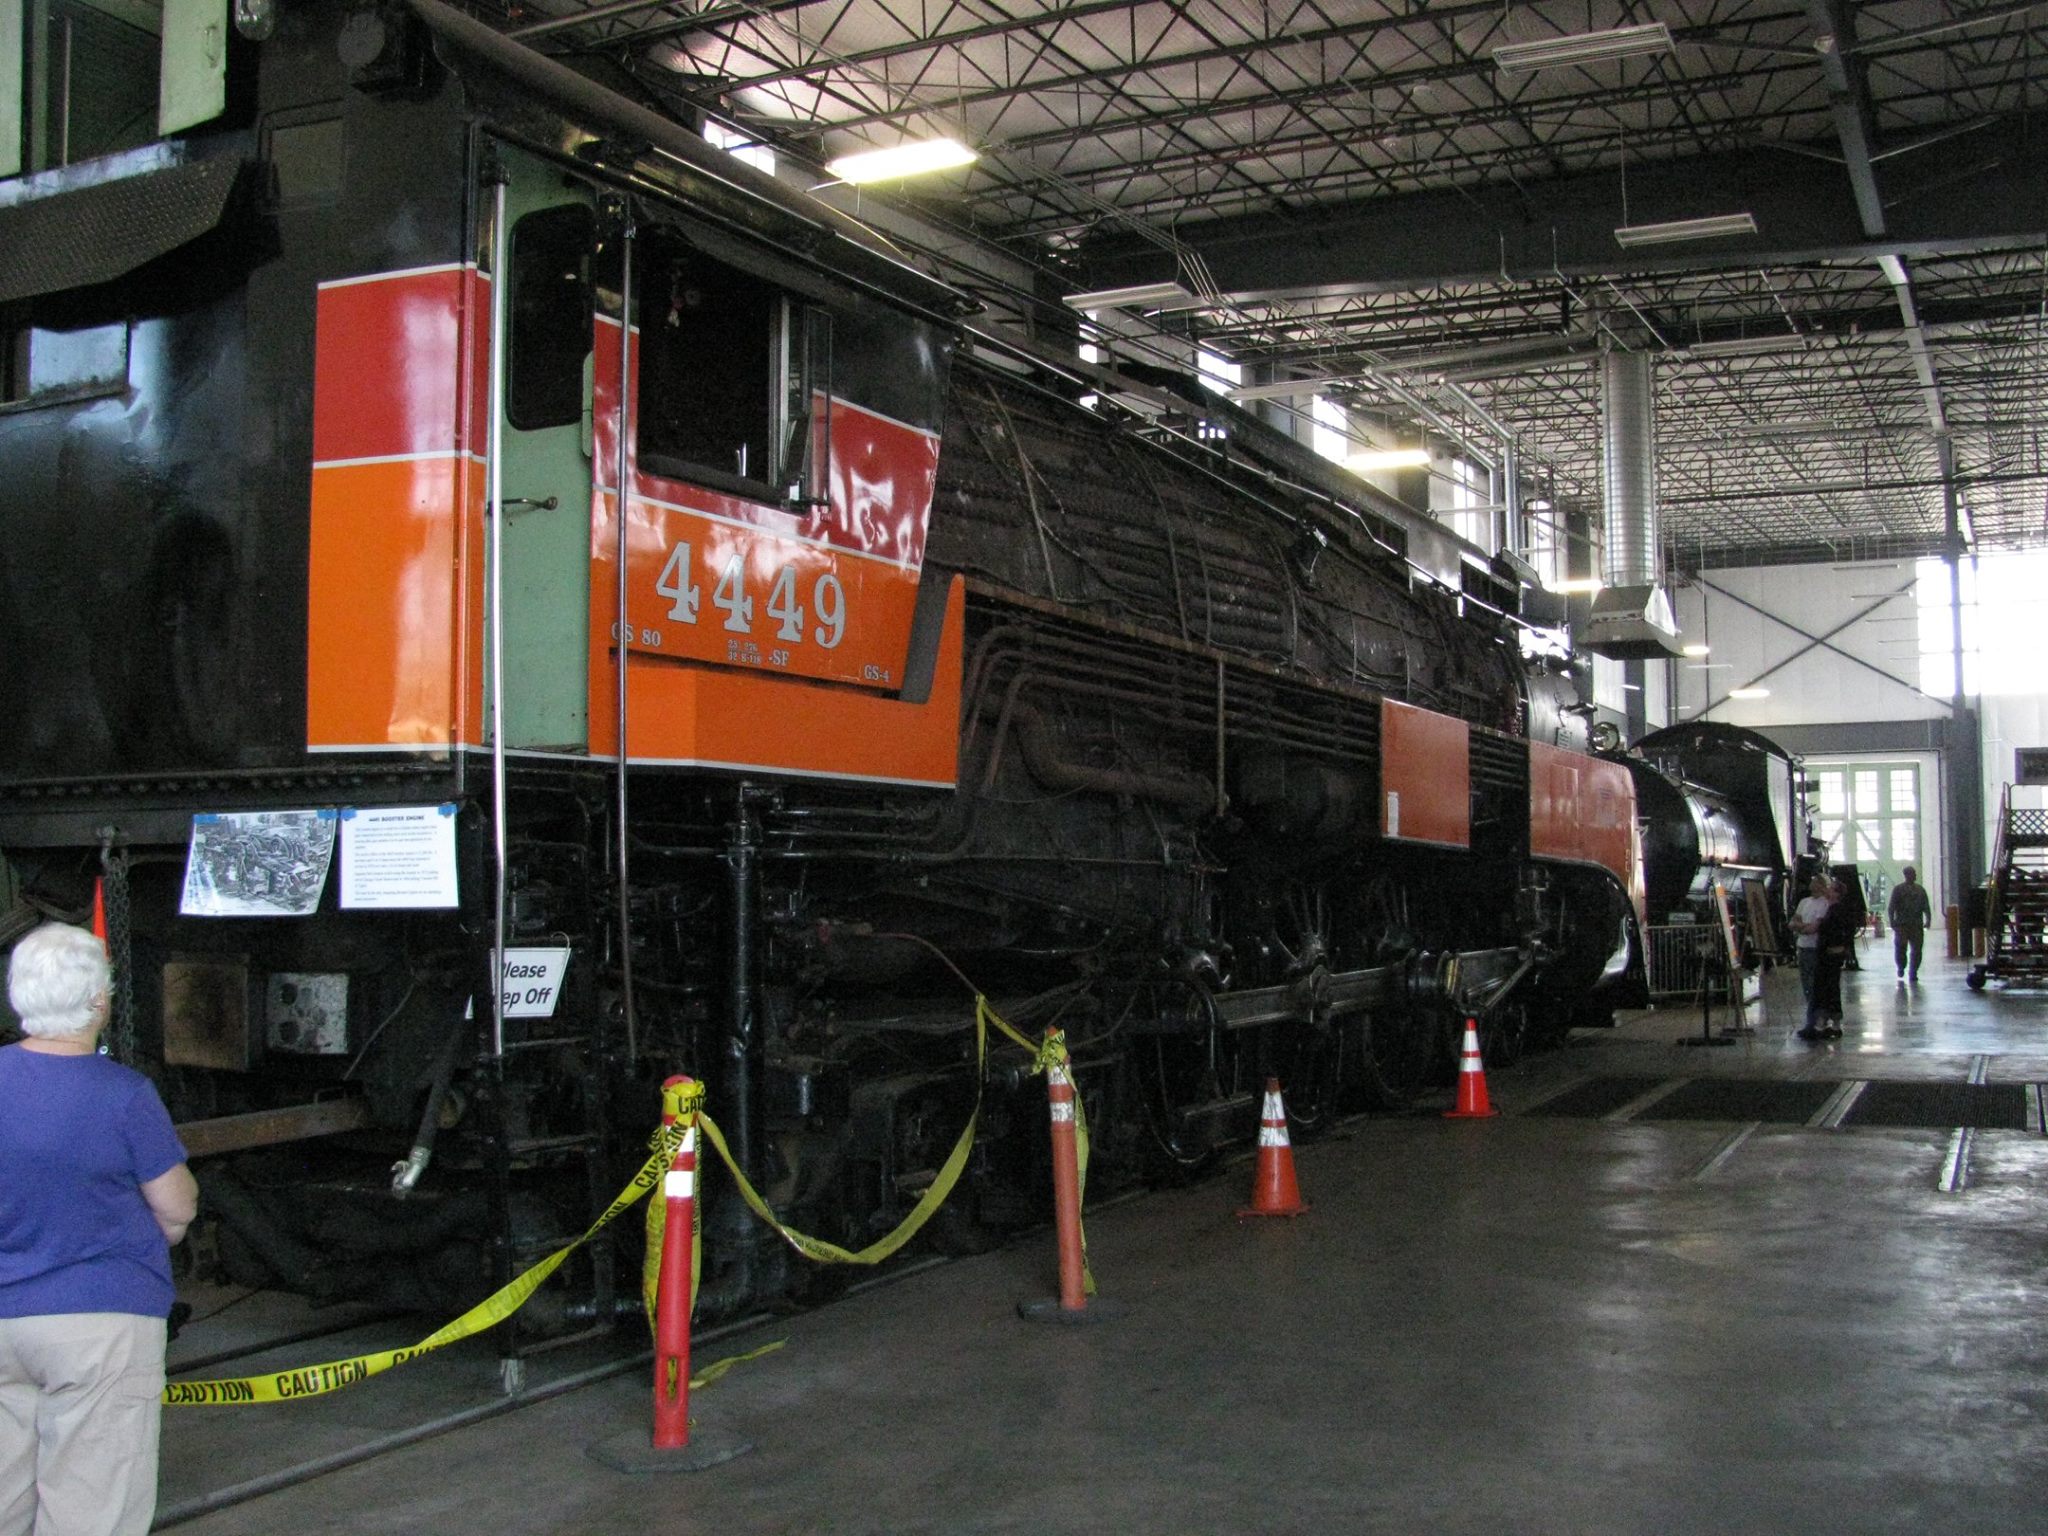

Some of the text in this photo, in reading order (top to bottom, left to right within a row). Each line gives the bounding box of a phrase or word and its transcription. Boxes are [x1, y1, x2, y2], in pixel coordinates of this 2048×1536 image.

[656, 541, 845, 649] 4449
[641, 628, 661, 647] 80
[864, 664, 889, 682] GS-4
[525, 988, 552, 1005] Off
[276, 1359, 368, 1398] CAUTION
[165, 1380, 254, 1403] CAUTION
